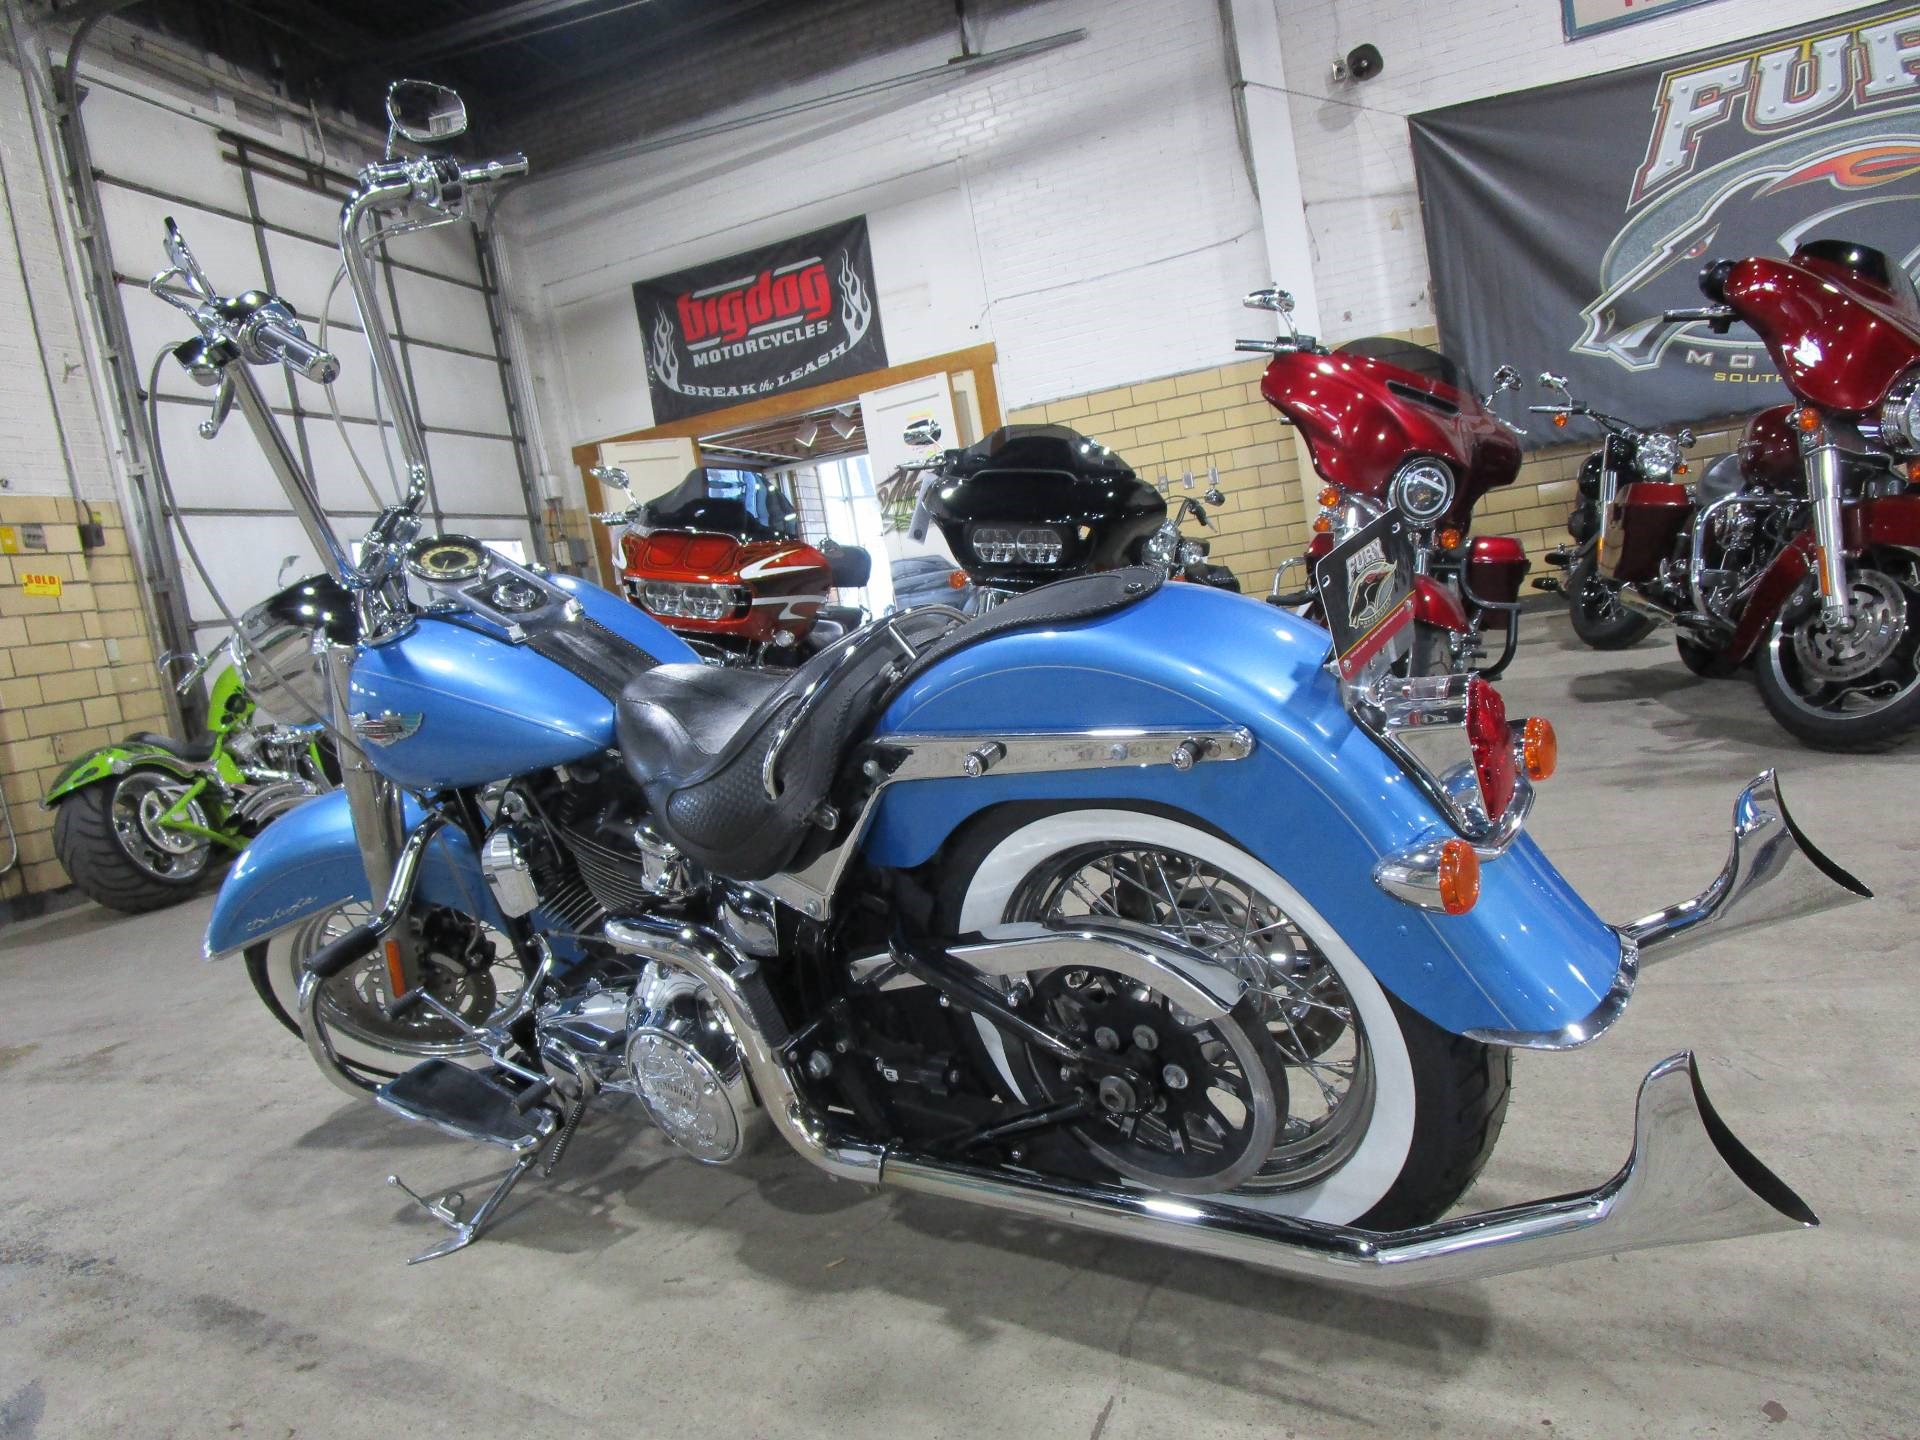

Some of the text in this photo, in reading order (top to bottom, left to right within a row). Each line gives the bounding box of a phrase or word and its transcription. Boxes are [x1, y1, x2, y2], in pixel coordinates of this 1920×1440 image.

[692, 319, 829, 368] MOTORCYCLES
[1685, 349, 1772, 369] MO
[682, 341, 849, 398] BREAK the LEASH
[26, 574, 57, 585] SOLD
